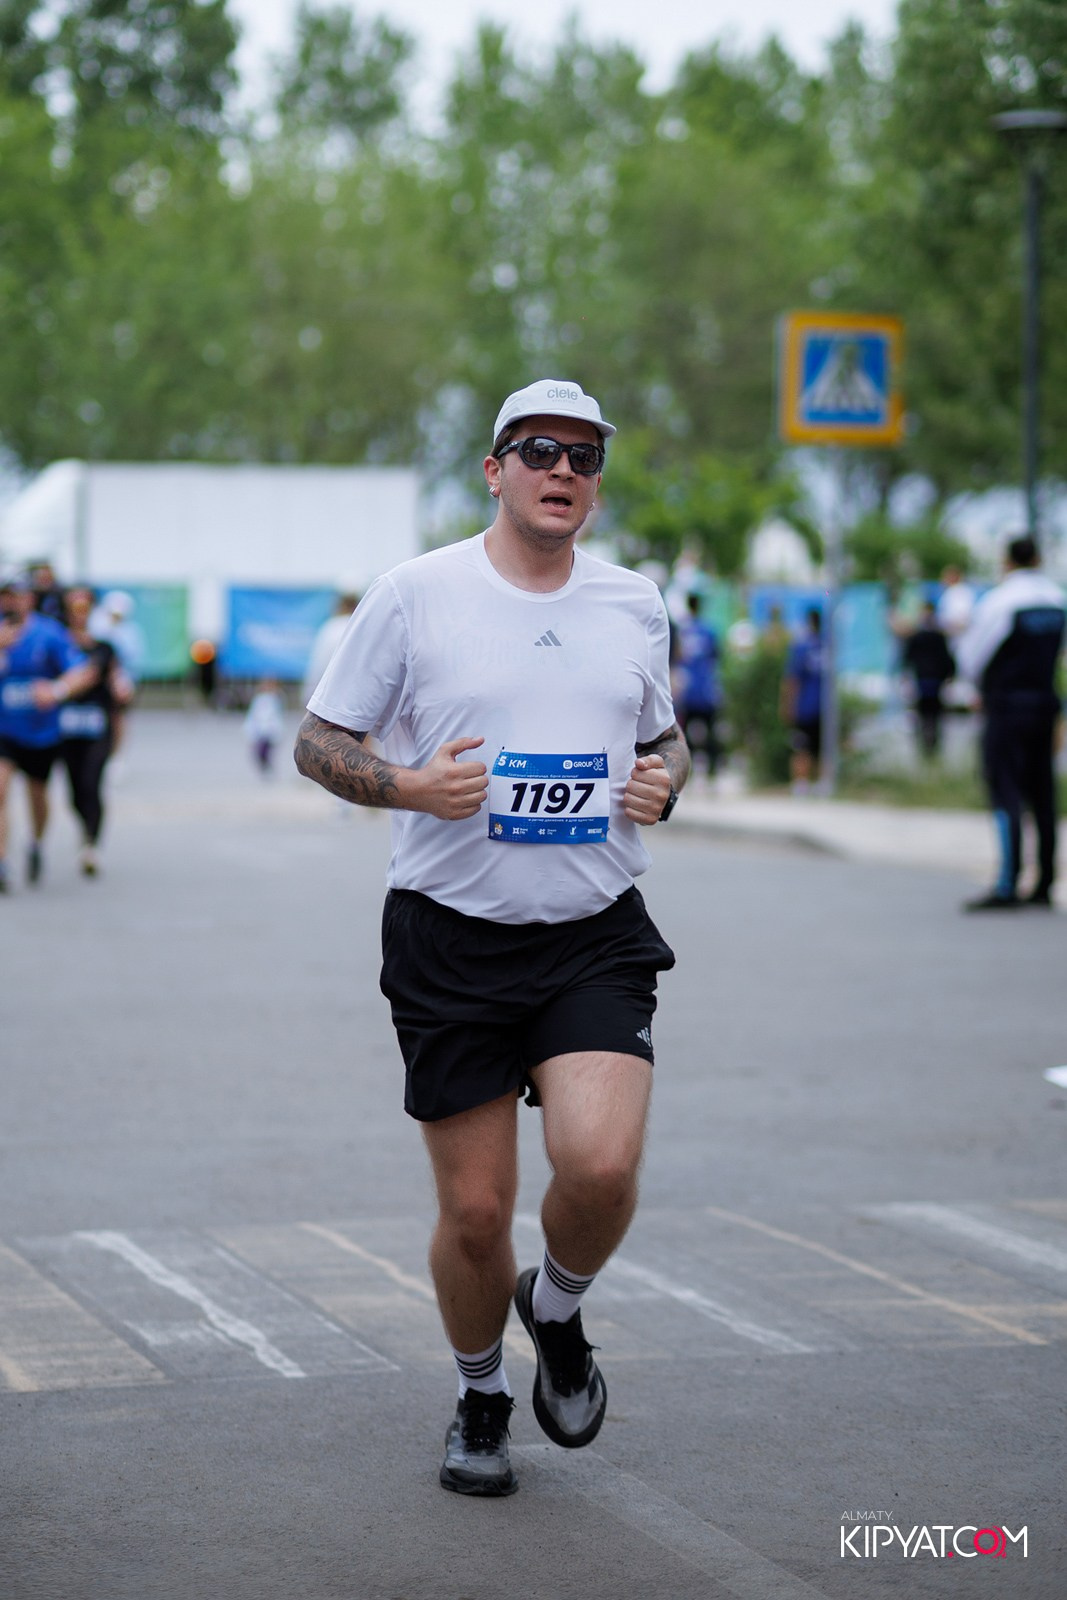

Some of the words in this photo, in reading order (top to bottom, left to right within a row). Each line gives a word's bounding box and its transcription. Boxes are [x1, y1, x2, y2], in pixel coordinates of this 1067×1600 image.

[498, 755, 507, 767] 5
[508, 759, 527, 769] KM
[510, 783, 595, 814] 1197
